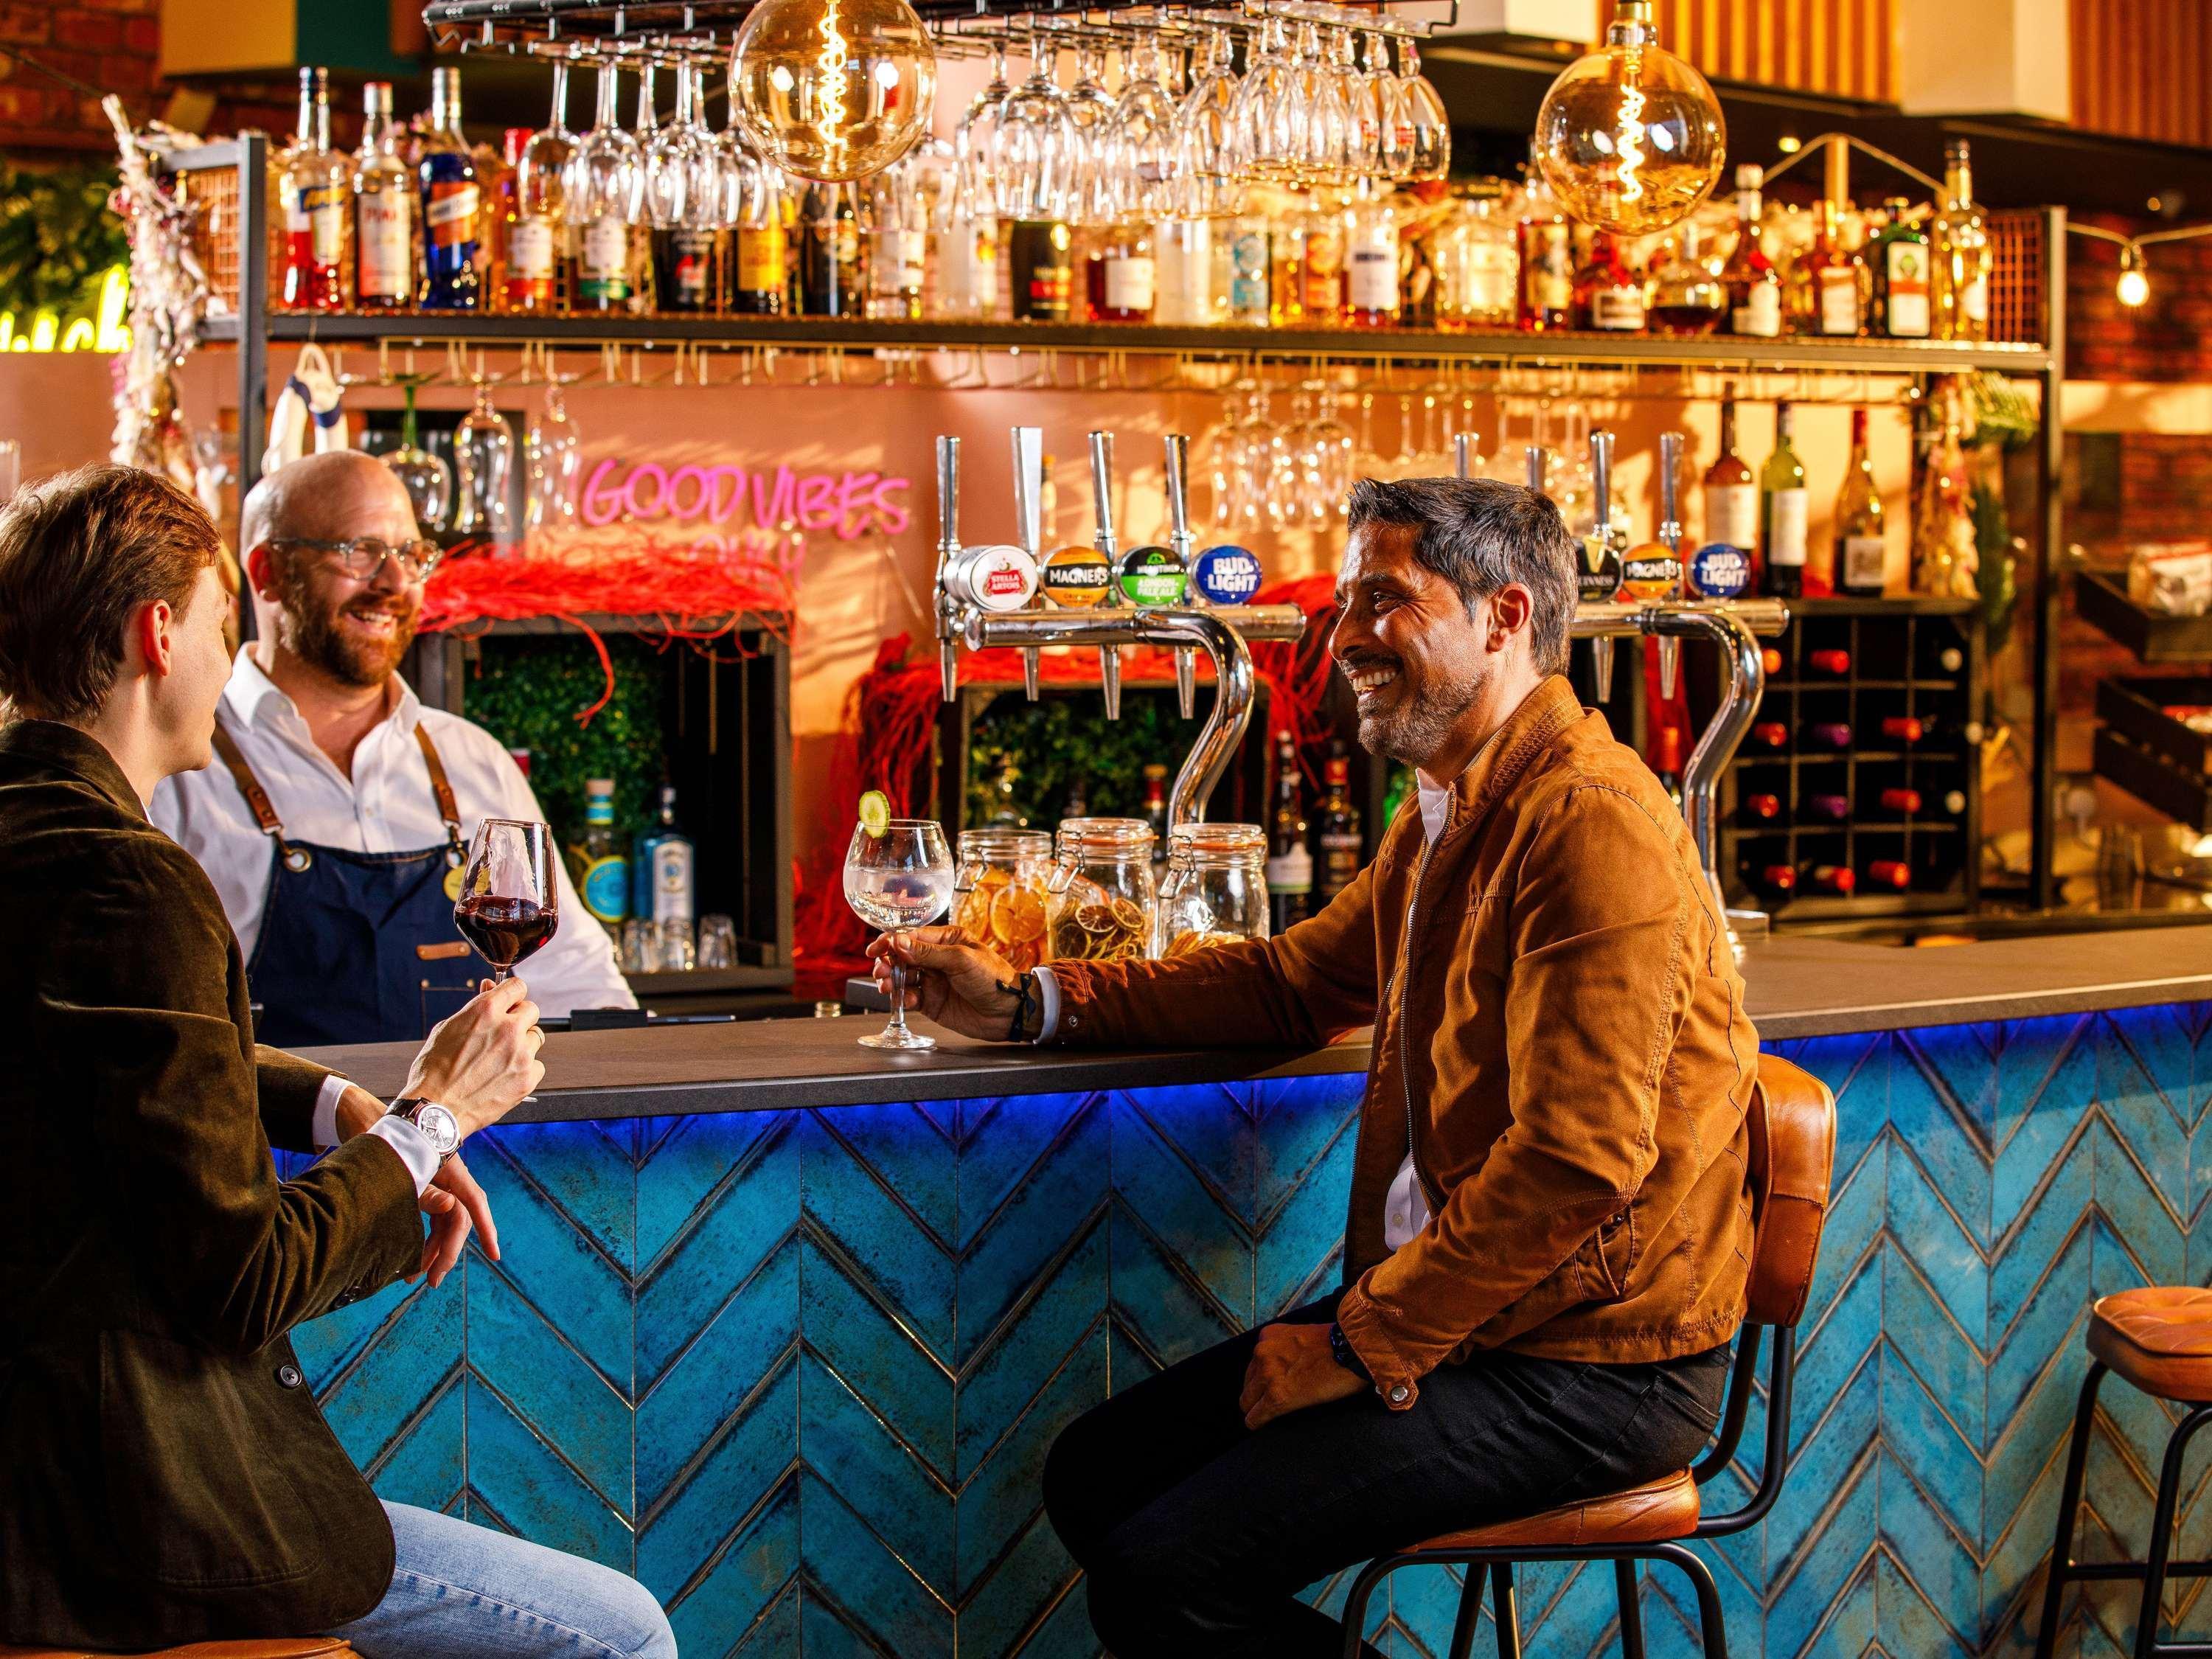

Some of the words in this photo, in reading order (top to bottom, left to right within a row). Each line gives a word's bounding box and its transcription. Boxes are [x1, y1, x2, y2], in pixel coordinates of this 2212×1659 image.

[582, 459, 746, 526] GOOD
[754, 465, 910, 539] VIBES
[1213, 557, 1251, 574] BUD
[1707, 553, 1741, 570] BUD
[992, 574, 1019, 583] STELLA
[1050, 567, 1107, 584] MAGNERS
[1208, 574, 1257, 592] LIGHT
[1702, 568, 1746, 586] LIGHT
[992, 582, 1020, 591] ARTOIS
